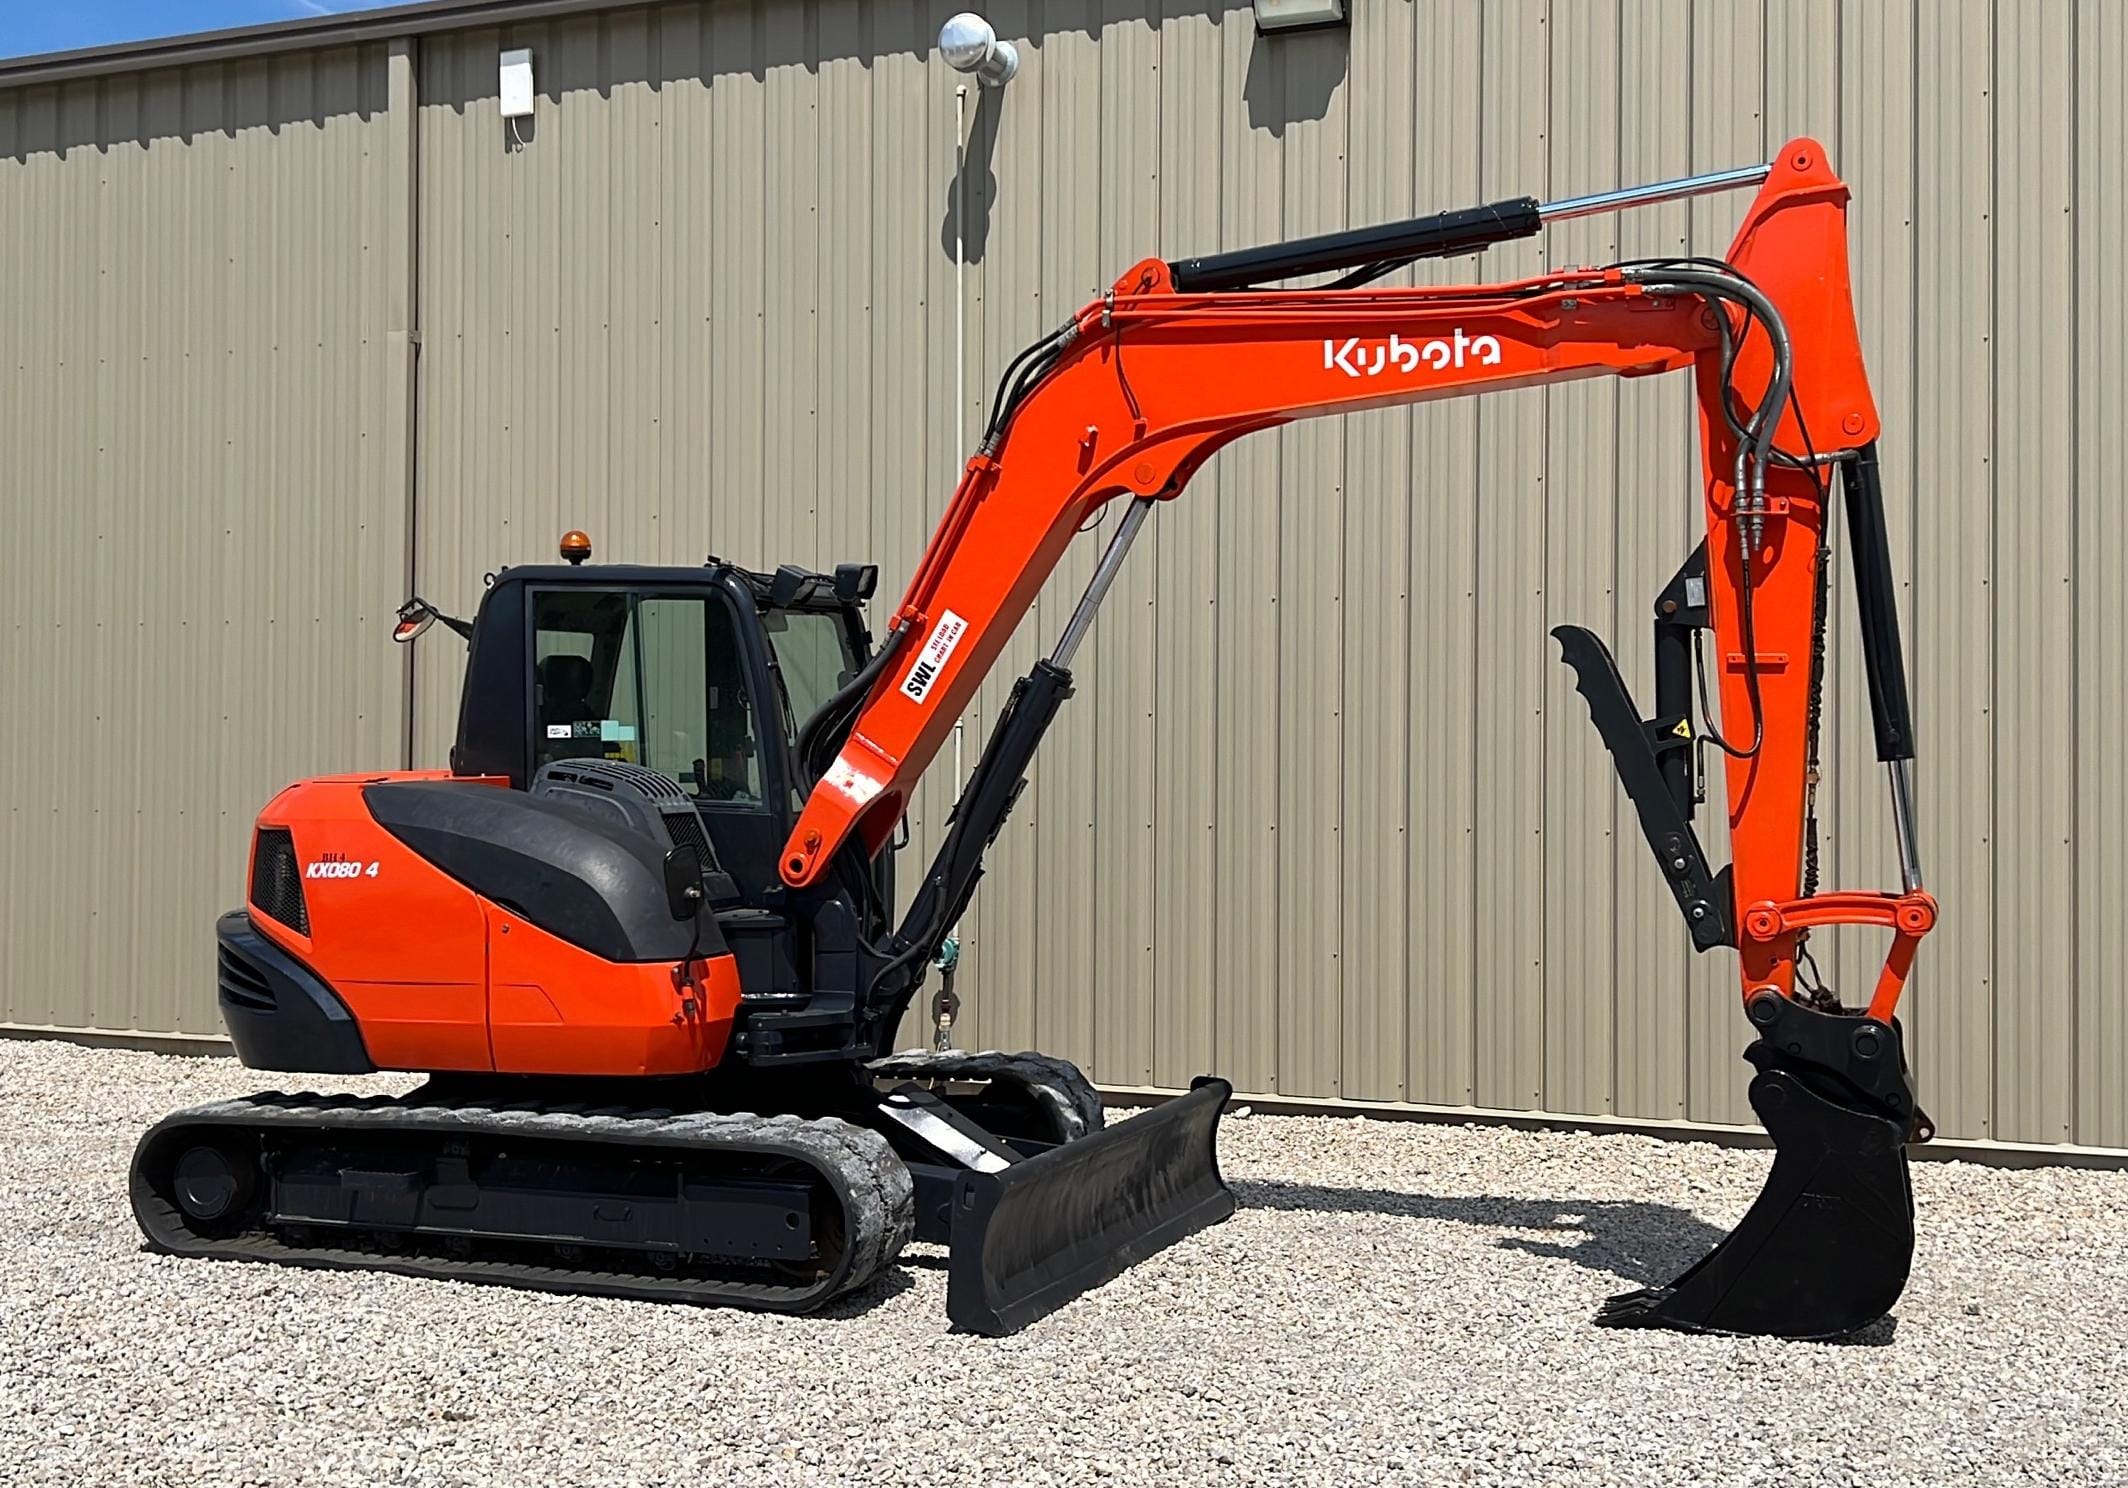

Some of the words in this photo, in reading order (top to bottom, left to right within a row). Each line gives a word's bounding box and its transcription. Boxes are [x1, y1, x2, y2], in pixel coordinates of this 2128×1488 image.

[1324, 327, 1501, 377] Kubota
[907, 661, 936, 696] SWL
[306, 862, 362, 878] KX080
[365, 862, 380, 878] 4
